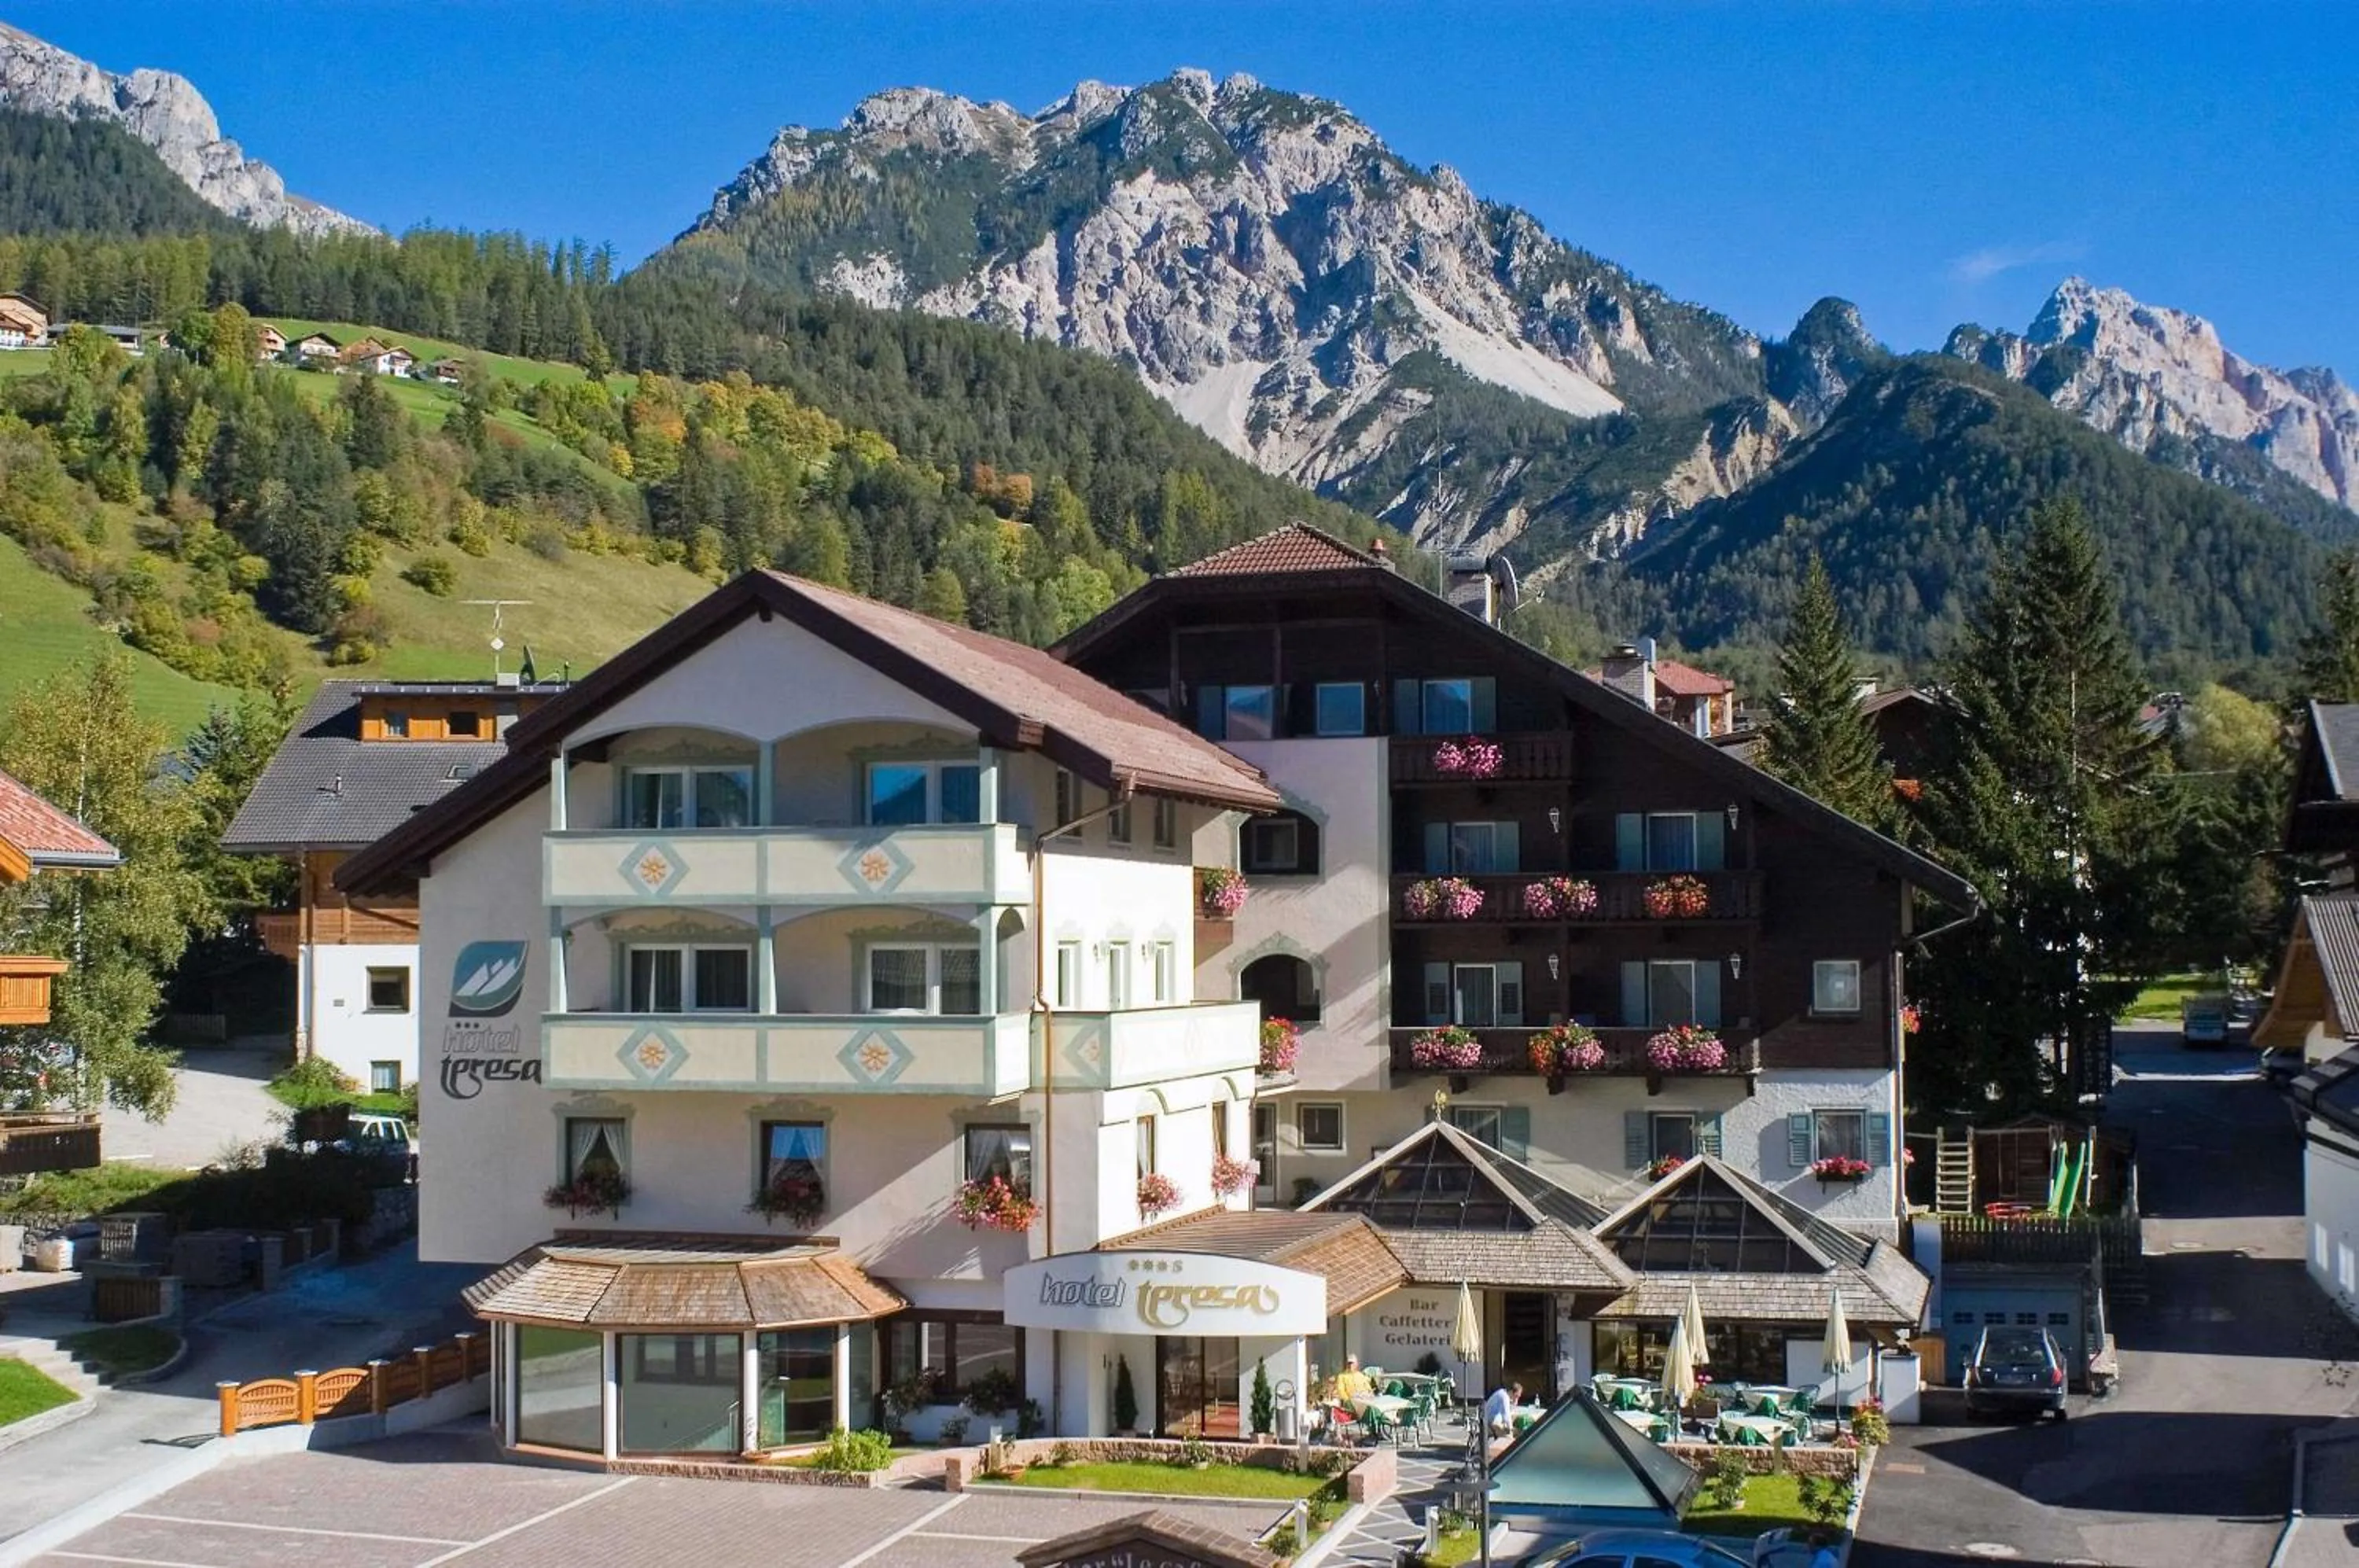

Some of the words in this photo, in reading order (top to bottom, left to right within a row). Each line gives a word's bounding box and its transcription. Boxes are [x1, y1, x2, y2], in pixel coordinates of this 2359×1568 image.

[443, 1024, 521, 1052] hotel
[440, 1055, 542, 1099] teresa
[1040, 1272, 1126, 1307] hotel
[1137, 1280, 1279, 1328] teresa
[1410, 1298, 1439, 1310] Bar
[1379, 1315, 1453, 1328] Caffetter
[1385, 1333, 1451, 1345] Gelateri
